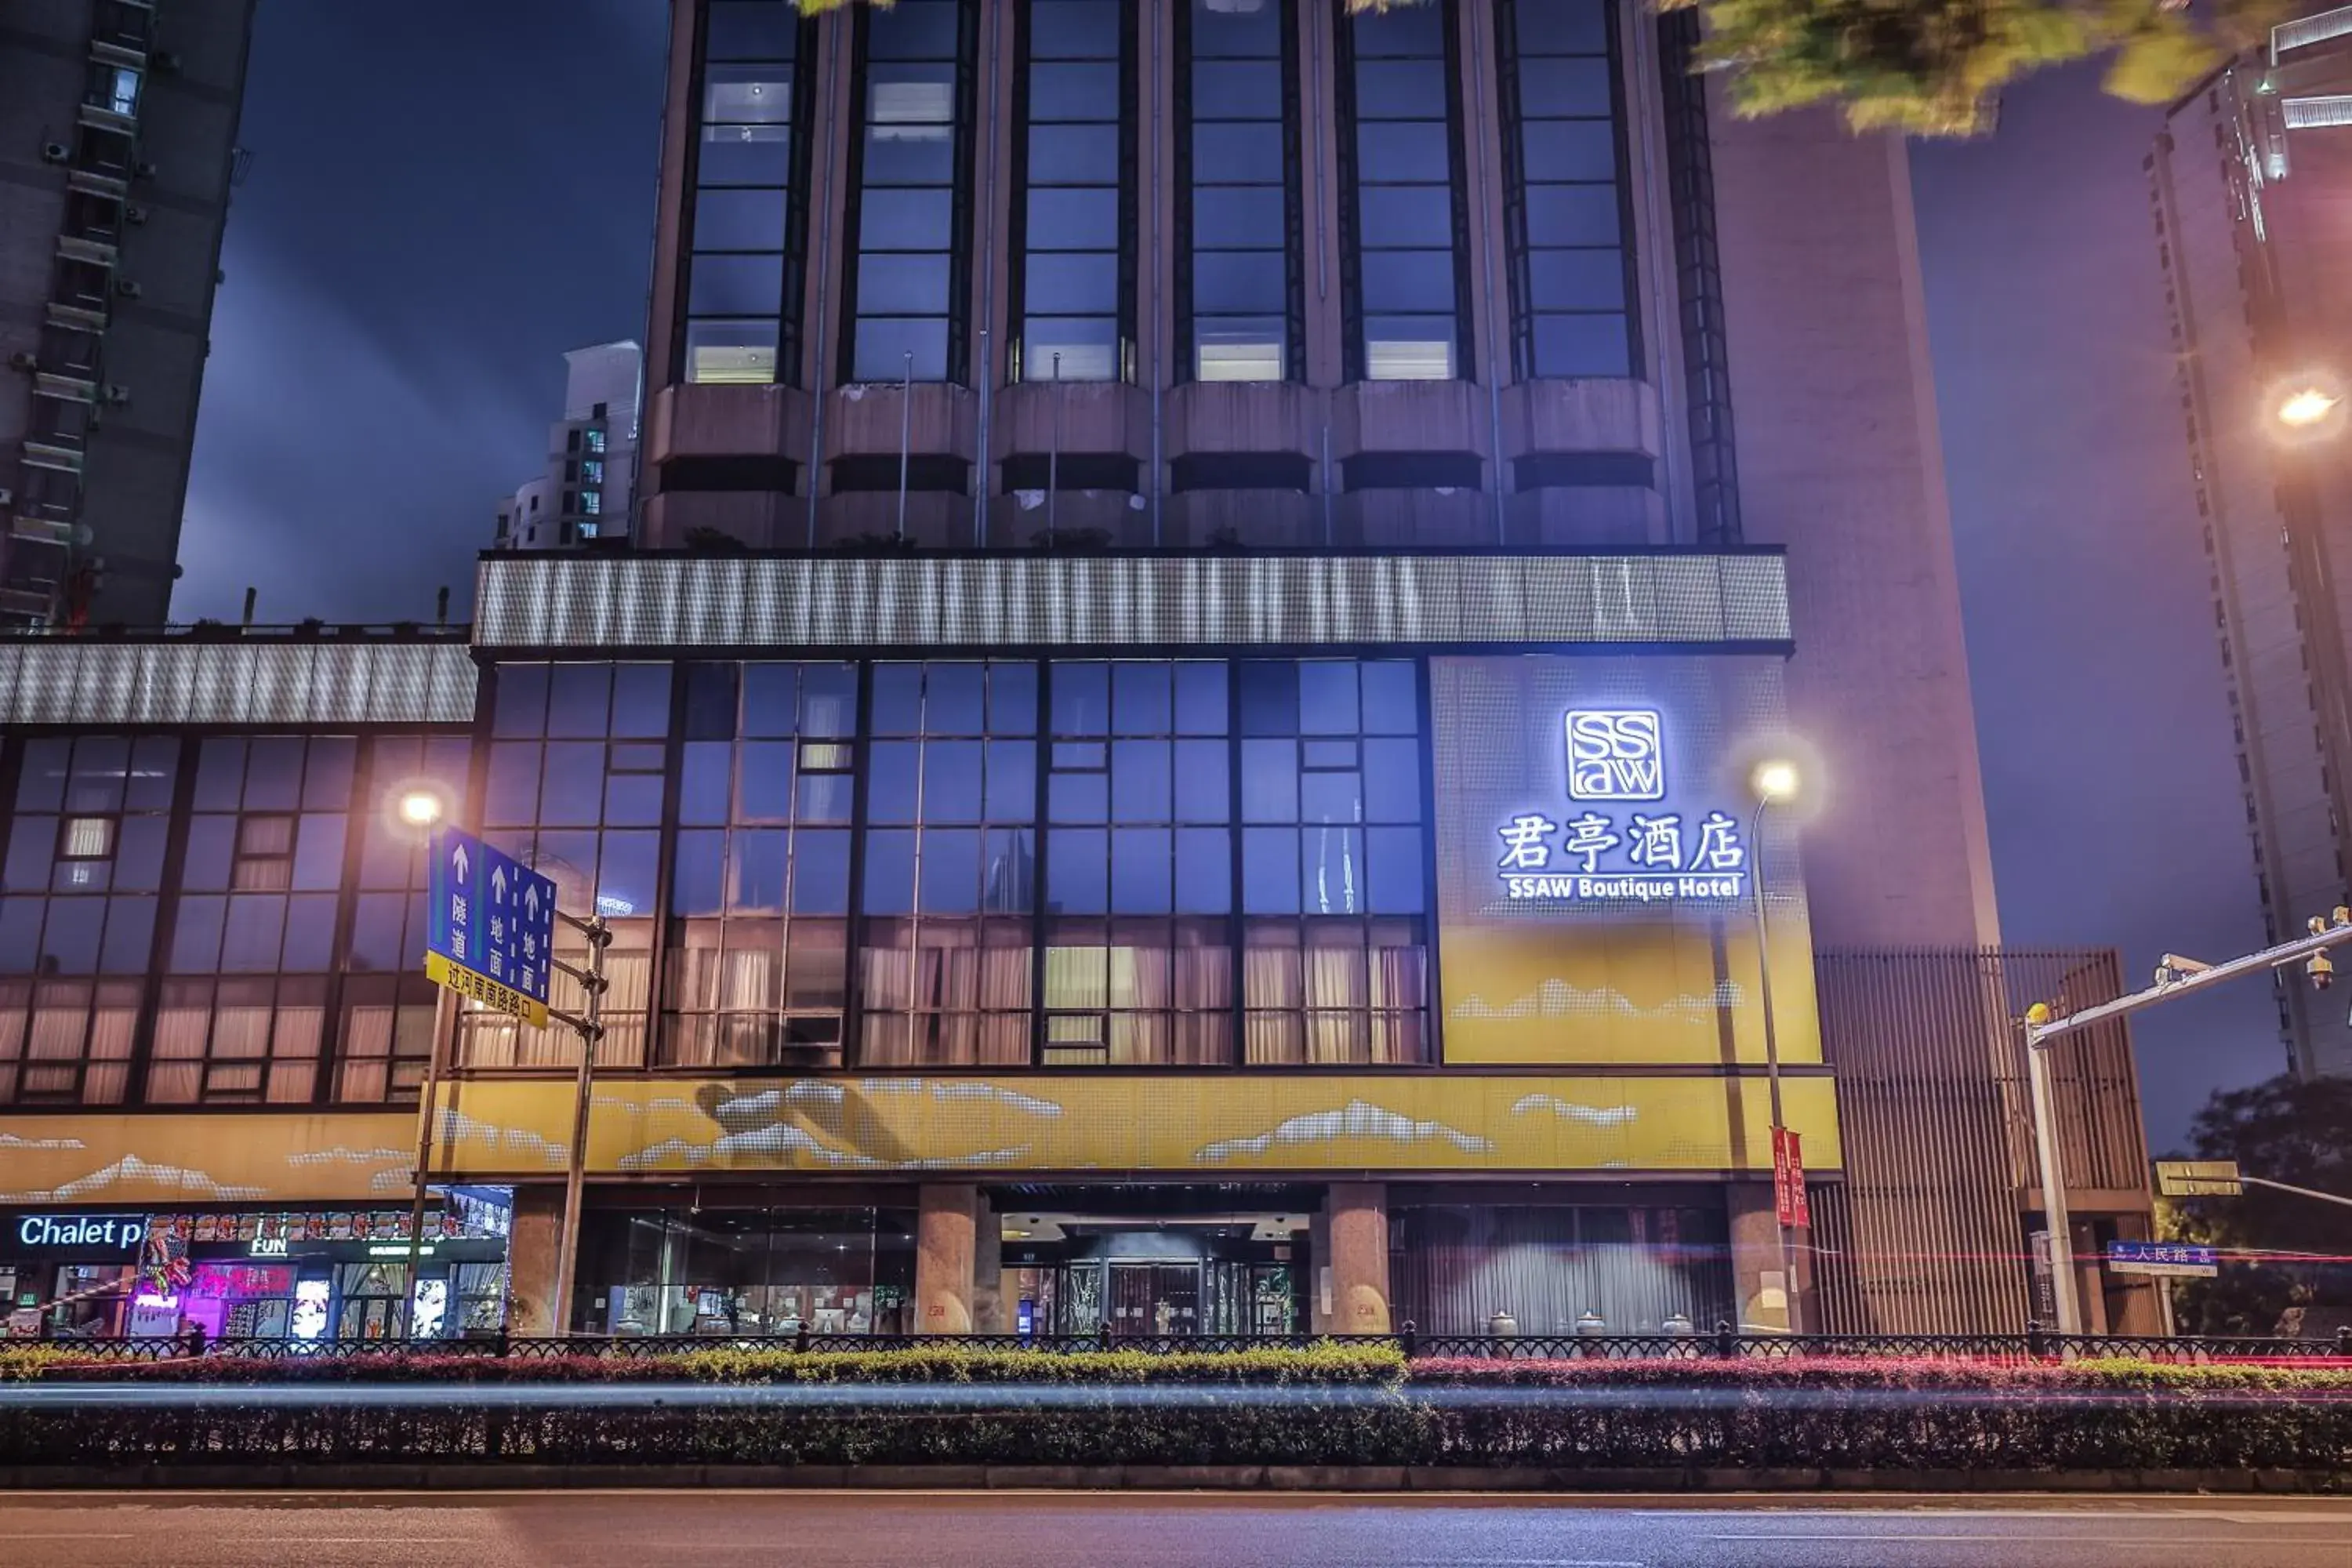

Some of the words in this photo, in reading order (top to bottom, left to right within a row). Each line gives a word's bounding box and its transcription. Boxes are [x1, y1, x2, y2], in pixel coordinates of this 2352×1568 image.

[1498, 812, 1745, 873] 君亭酒店
[1508, 877, 1572, 898] SSAW
[1578, 878, 1675, 902] Boutique
[1679, 877, 1740, 897] Hotel
[451, 892, 468, 961] 隧道
[489, 915, 504, 978] 地面
[521, 931, 536, 993] 地面
[20, 1218, 115, 1245] Chalet
[251, 1237, 287, 1253] FUN
[2136, 1246, 2189, 1263] 人民路
